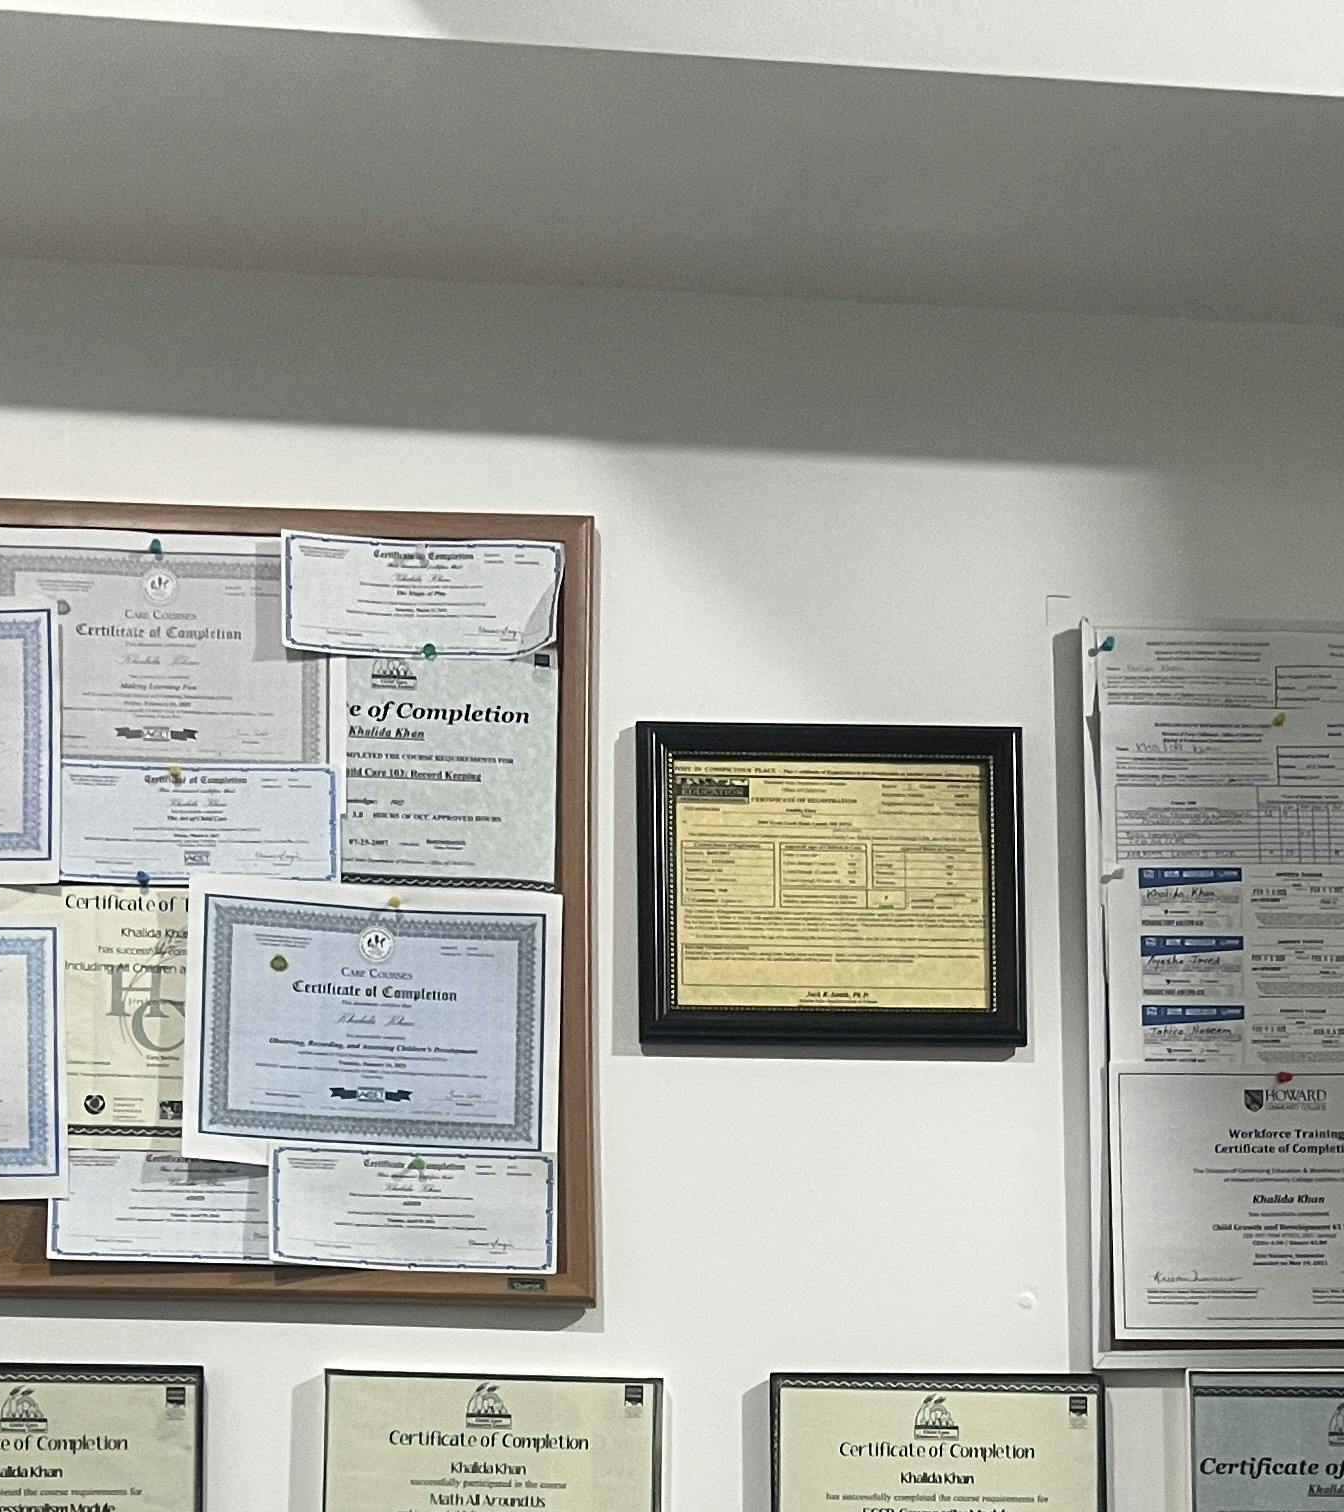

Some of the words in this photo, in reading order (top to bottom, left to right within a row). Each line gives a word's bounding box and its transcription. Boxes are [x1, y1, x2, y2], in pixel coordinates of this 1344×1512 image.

[76, 624, 144, 638] Certificate
[150, 626, 161, 638] of
[166, 626, 241, 641] Completion
[368, 702, 394, 719] of
[397, 702, 530, 724] Completion
[348, 726, 392, 739] Khalida
[395, 728, 425, 740] Khan
[365, 768, 386, 778] Care
[410, 770, 442, 780] Record
[445, 771, 481, 782] Keeping
[682, 788, 744, 796] EDUCATION
[1192, 889, 1215, 897] Khan
[66, 895, 155, 913] Certificate
[159, 896, 177, 912] of
[121, 927, 161, 939] Khalida
[65, 961, 113, 973] Including
[117, 961, 129, 972] All
[133, 962, 176, 973] Children
[292, 981, 361, 997] Certificate
[365, 985, 377, 998] of
[382, 985, 457, 1002] Completion
[1265, 1089, 1327, 1101] HOWARD
[1229, 1129, 1291, 1139] Workforce
[1295, 1129, 1344, 1141] Training
[1215, 1143, 1275, 1154] Certificate
[1278, 1143, 1289, 1154] of
[1252, 1194, 1293, 1204] Khalida
[1297, 1194, 1325, 1204] Khan
[14, 1436, 33, 1451] of
[37, 1436, 128, 1454] Completion
[390, 1430, 477, 1447] Certificate
[480, 1432, 498, 1448] of
[502, 1432, 589, 1452] Completion
[840, 1442, 925, 1458] Certificate
[929, 1442, 947, 1457] of
[950, 1443, 1035, 1461] Completion
[30, 1466, 63, 1478] Khan
[451, 1462, 493, 1474] Khalida
[495, 1463, 526, 1475] Khan
[1200, 1458, 1319, 1478] Certificate
[901, 1472, 942, 1484] Khalida
[944, 1472, 974, 1484] Khan
[430, 1493, 463, 1505] Math
[466, 1495, 480, 1505] All
[483, 1495, 528, 1508] Around
[530, 1496, 545, 1508] Us
